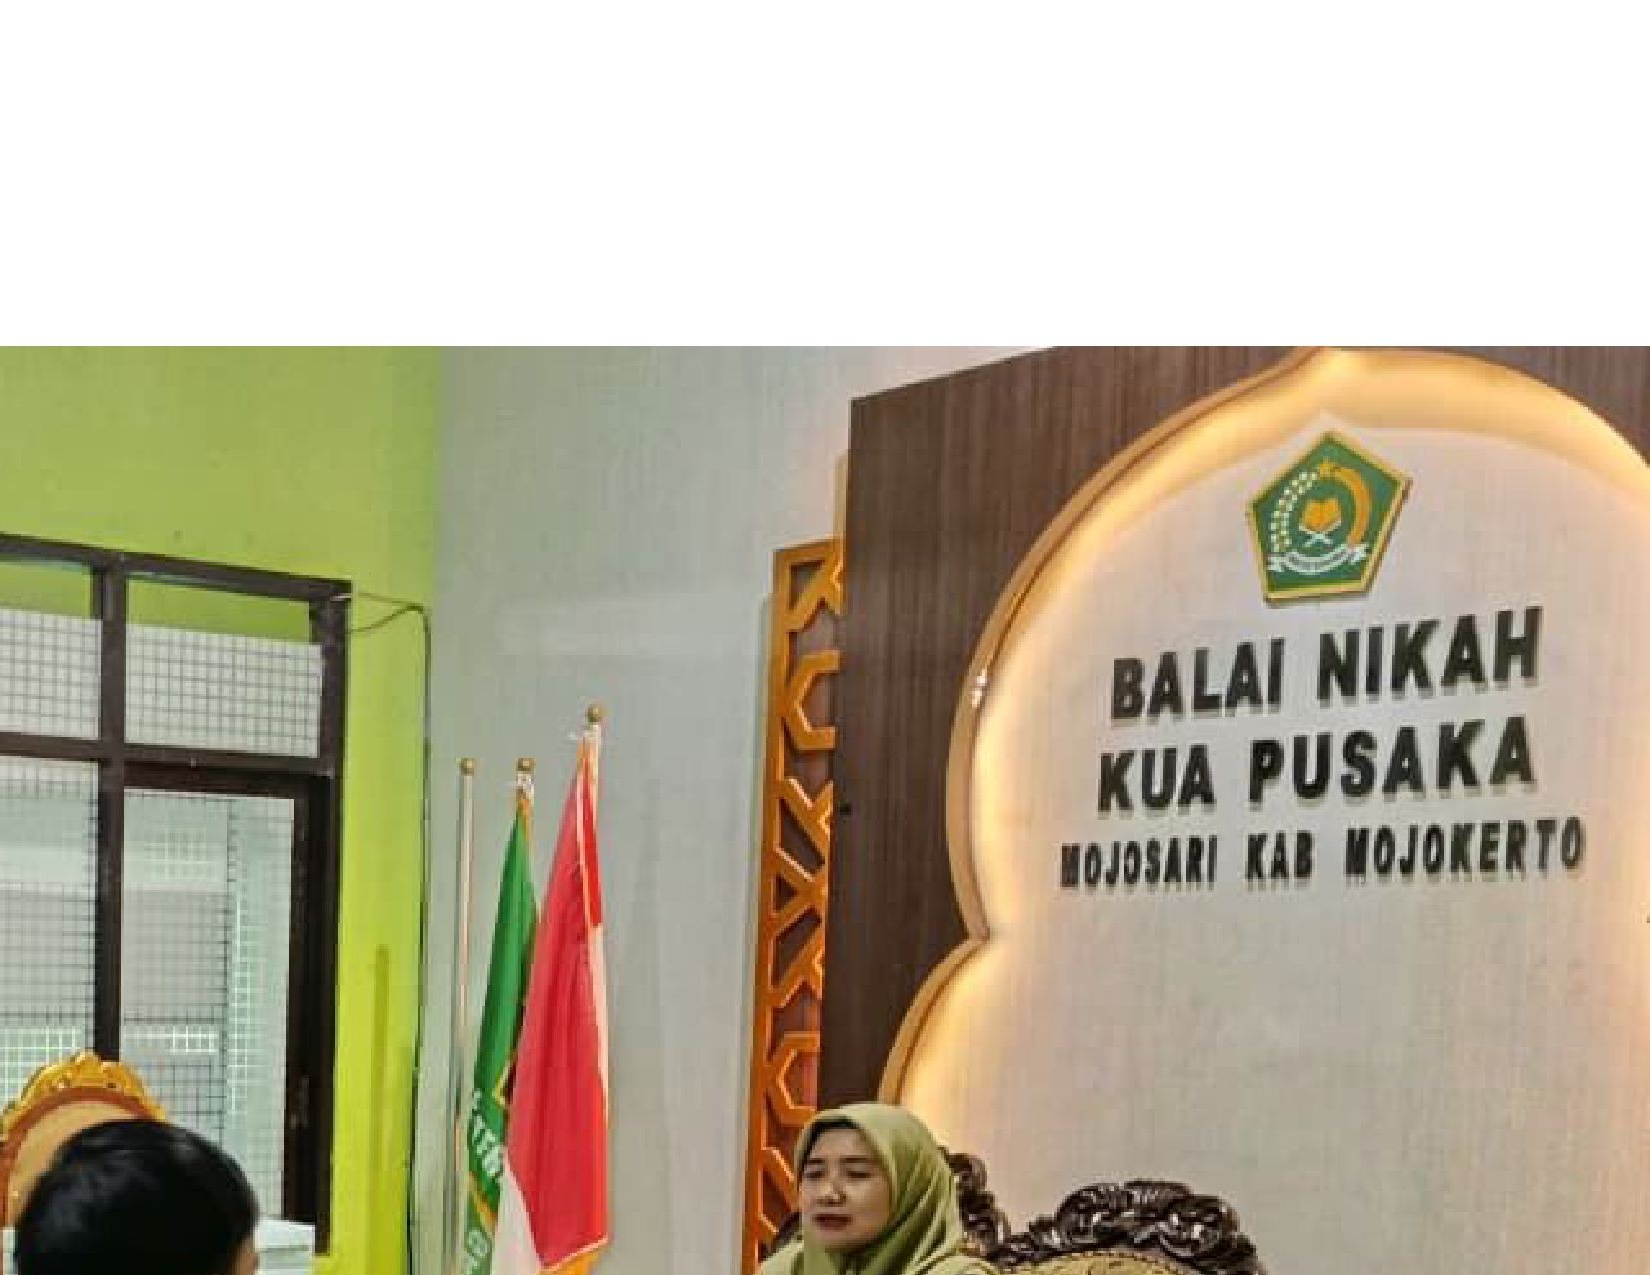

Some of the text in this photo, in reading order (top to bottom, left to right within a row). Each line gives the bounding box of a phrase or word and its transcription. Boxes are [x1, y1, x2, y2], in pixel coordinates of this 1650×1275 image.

[1111, 605, 1543, 722] BALAI NIKAH
[1097, 714, 1536, 814] KUA PUSAKA
[1060, 815, 1585, 889] MOJOSARI KAB MOJOKERTO
